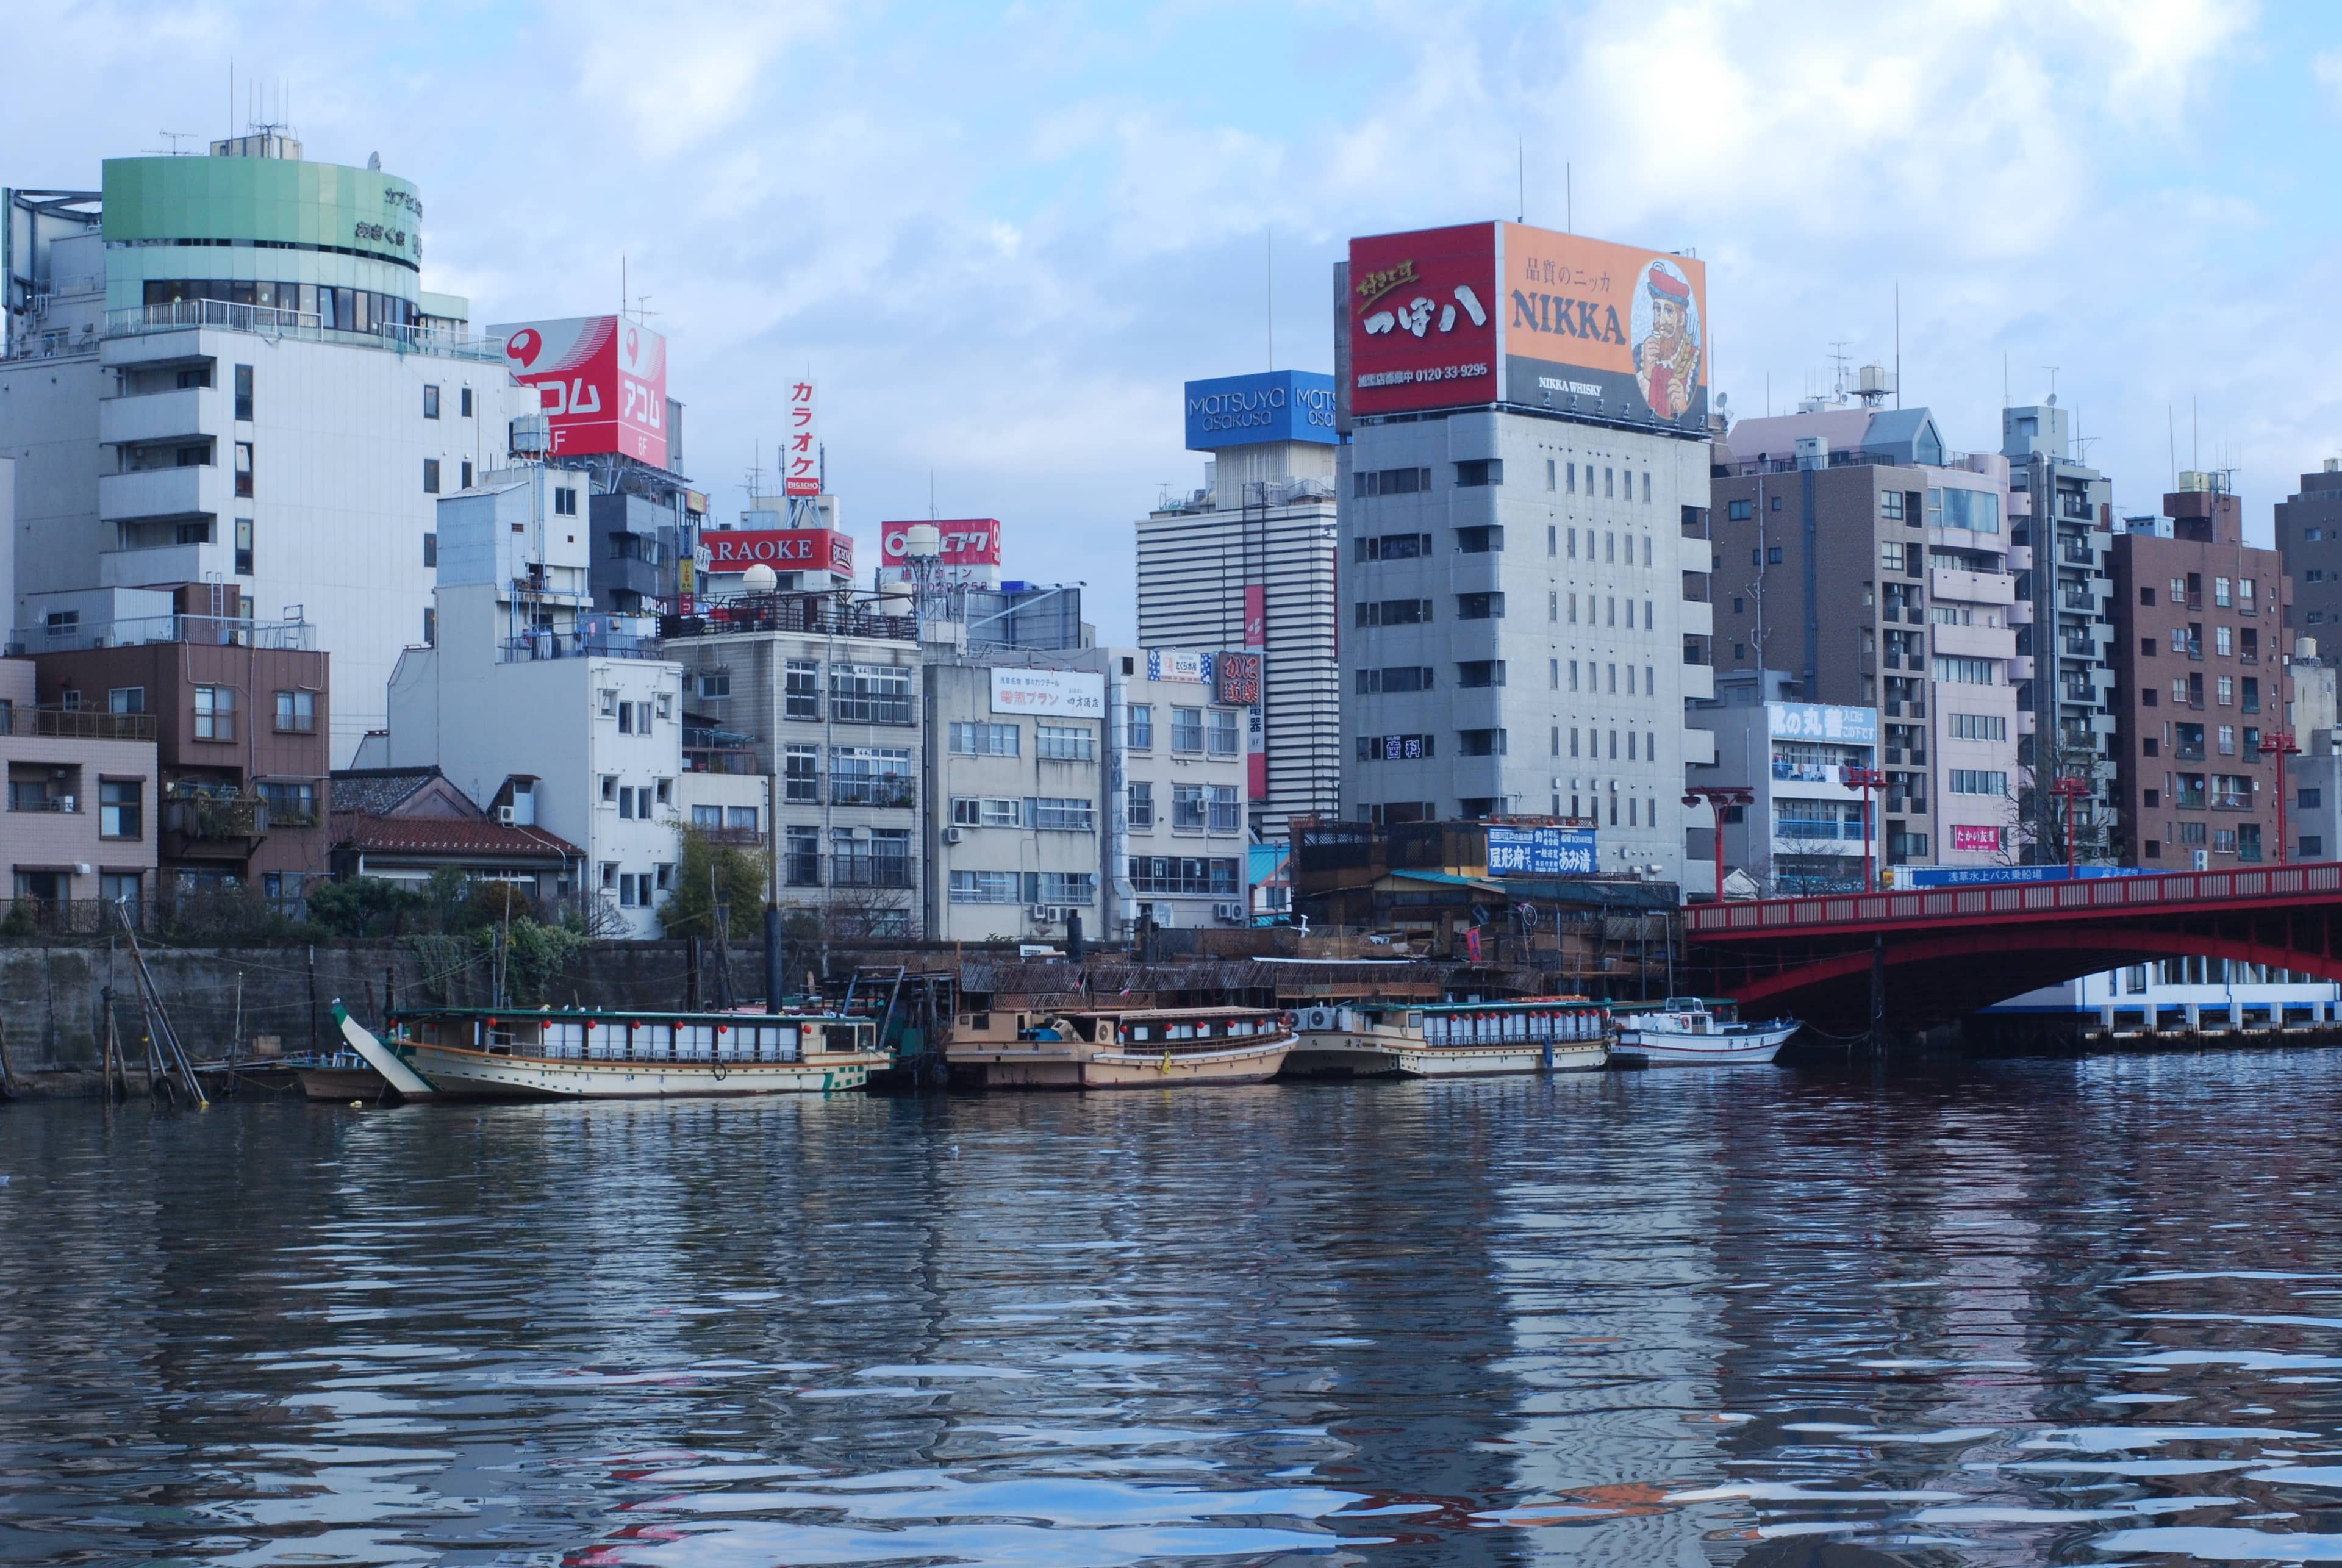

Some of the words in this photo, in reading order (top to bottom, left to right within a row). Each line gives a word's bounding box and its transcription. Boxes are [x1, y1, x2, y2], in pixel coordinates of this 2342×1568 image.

[1526, 257, 1611, 293] 品質のニッカ
[1364, 285, 1487, 337] つぼ八
[1511, 288, 1627, 345] NIKKA
[1415, 362, 1488, 382] 0120-33-9295
[525, 378, 601, 417] コム
[1538, 376, 1569, 392] NIKKA
[1568, 381, 1602, 397] WHISKY
[624, 379, 661, 429] アコム
[791, 382, 814, 476] カラオケ
[1225, 654, 1258, 679] かに
[1842, 726, 1875, 740] この下です
[1386, 739, 1420, 759] 歯科
[1559, 847, 1591, 873] あみ清
[1948, 868, 2043, 882] 浅草水上バス乗船場
